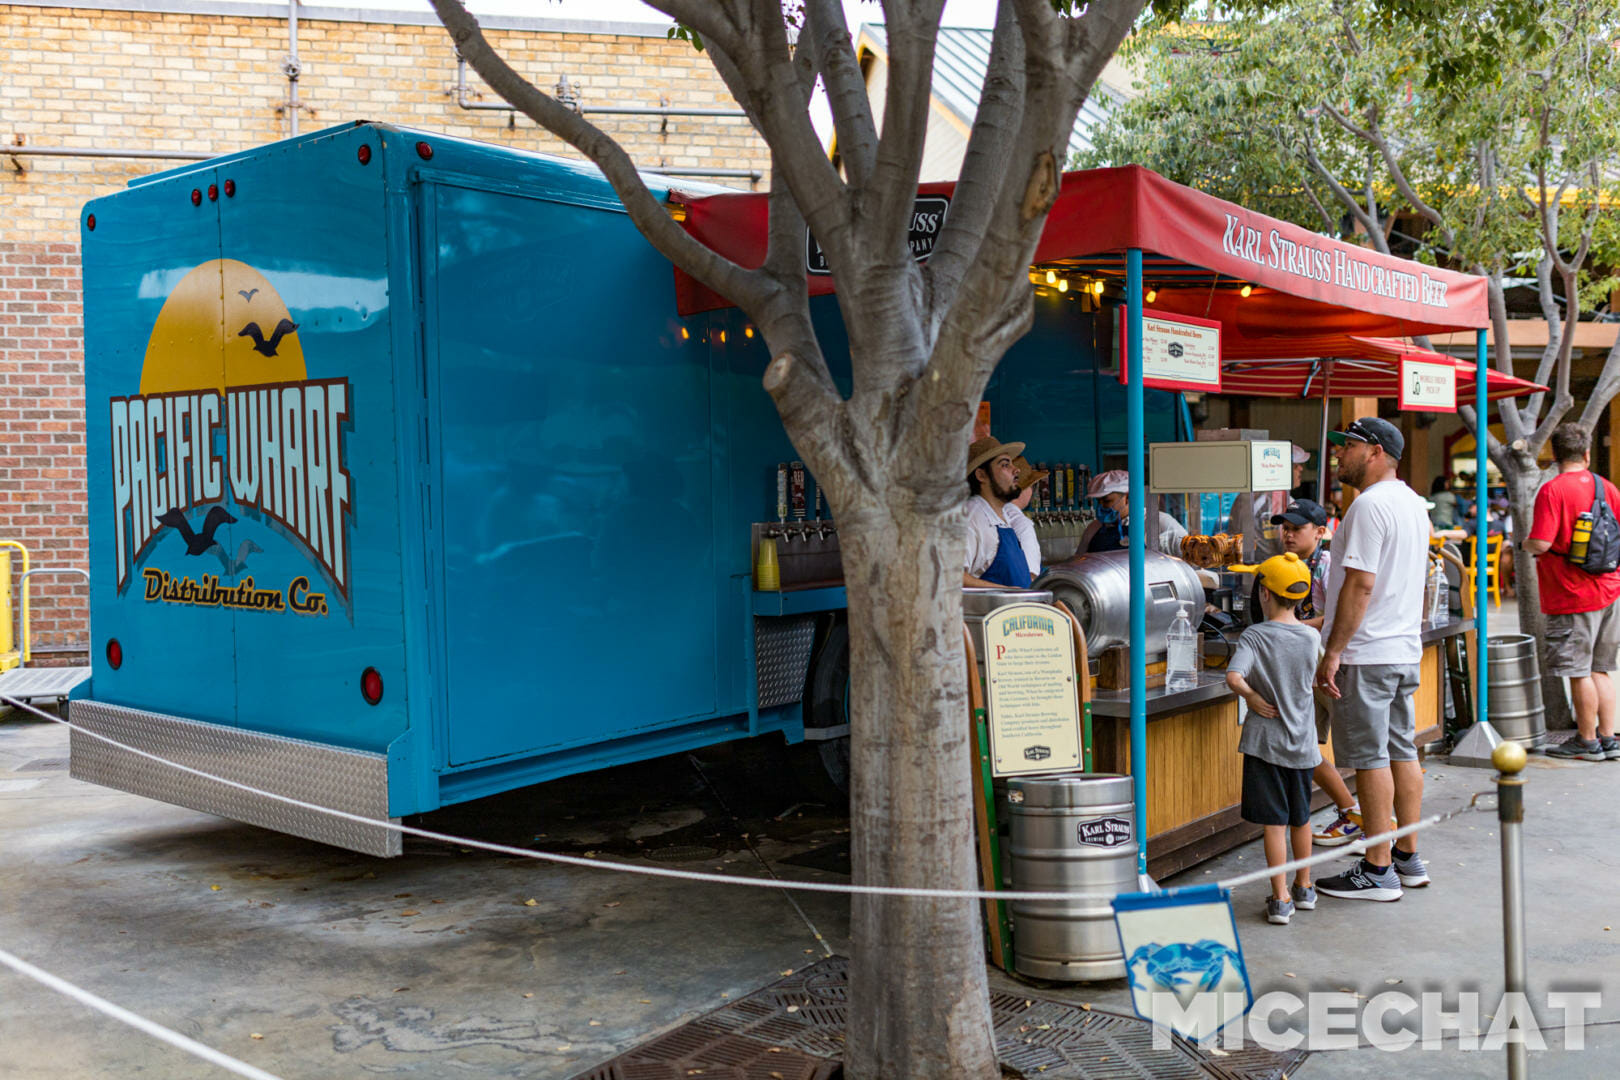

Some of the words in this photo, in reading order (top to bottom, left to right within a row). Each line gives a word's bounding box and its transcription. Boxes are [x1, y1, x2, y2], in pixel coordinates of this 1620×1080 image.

[1268, 229, 1331, 283] STRAUSS
[1334, 249, 1419, 303] HANDCRAFTED
[1421, 272, 1448, 308] BEER
[111, 389, 222, 596] PACIFIC
[225, 378, 351, 599] WHARF
[143, 567, 284, 610] Distribution
[288, 576, 328, 616] Co.
[1002, 614, 1055, 637] CALIFORNIA
